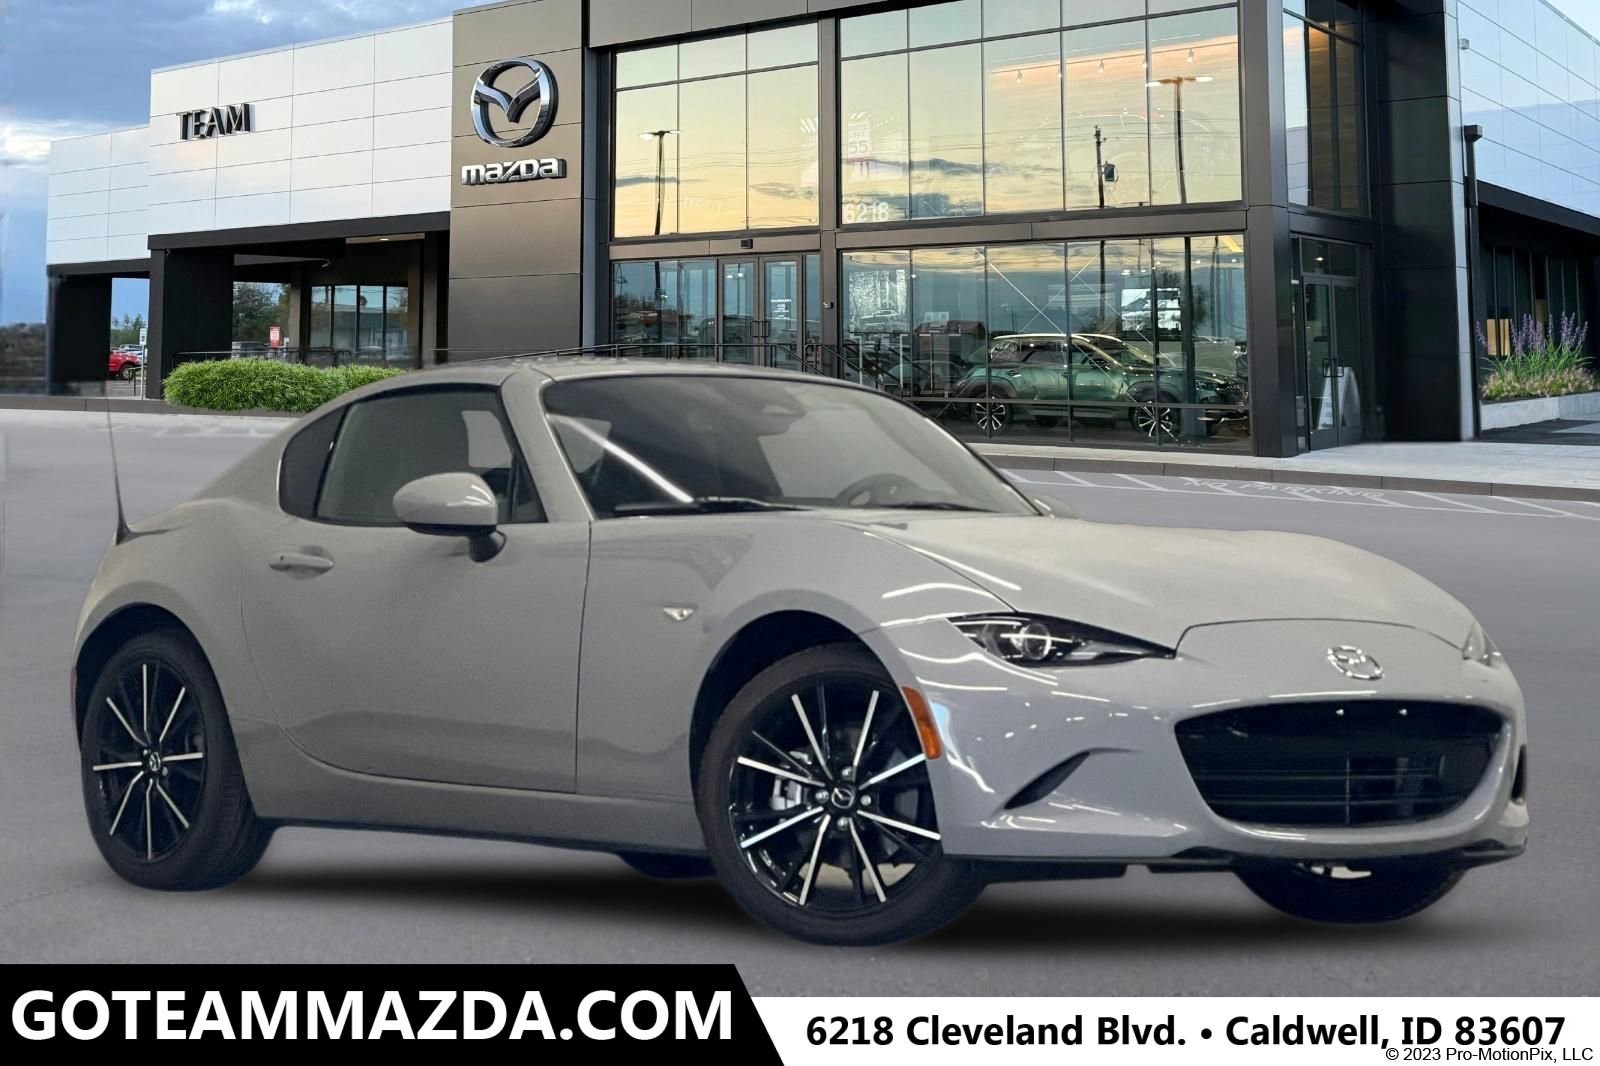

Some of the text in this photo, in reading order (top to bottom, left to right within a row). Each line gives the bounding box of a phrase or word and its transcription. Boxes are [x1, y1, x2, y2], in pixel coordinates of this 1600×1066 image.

[176, 103, 251, 141] TEAM
[849, 140, 868, 154] 55
[461, 157, 566, 186] mazda
[845, 201, 889, 223] 6218
